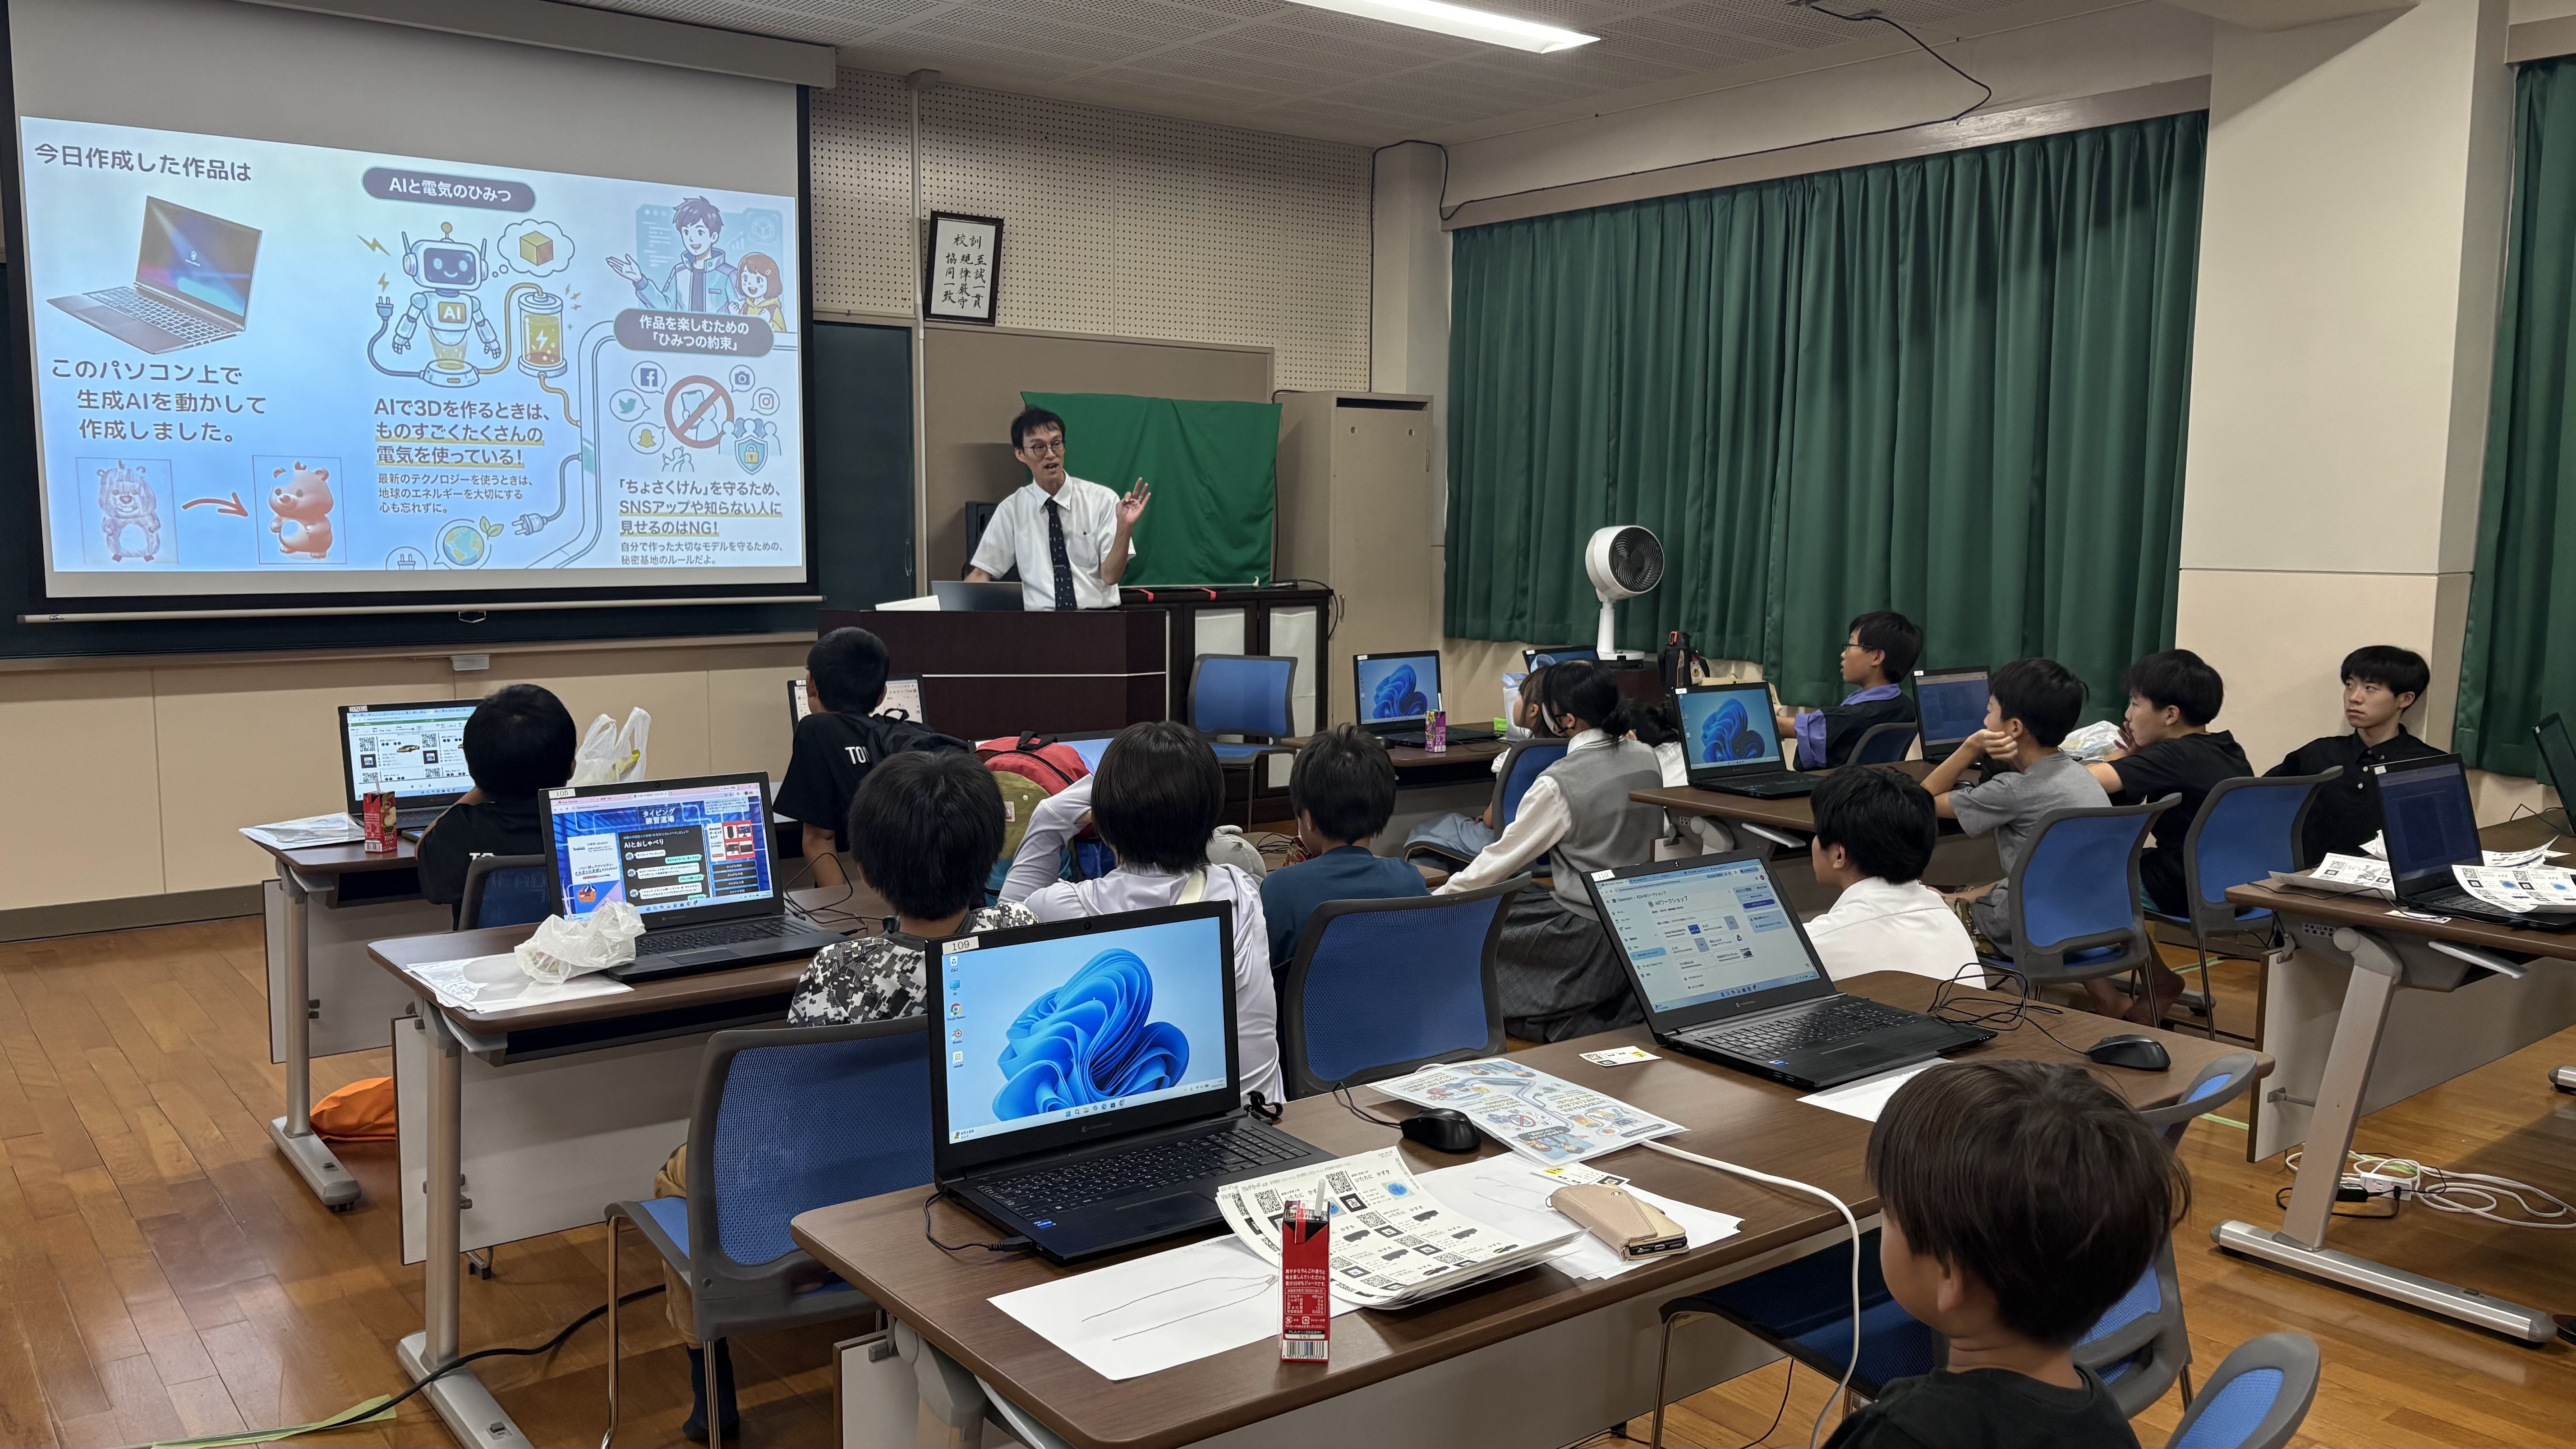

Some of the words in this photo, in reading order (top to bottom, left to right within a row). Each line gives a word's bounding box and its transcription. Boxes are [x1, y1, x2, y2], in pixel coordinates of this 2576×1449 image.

[35, 143, 251, 181] 今日作成した作品は
[389, 178, 511, 202] AIと電気のひみつ
[953, 234, 981, 249] 校訓
[971, 254, 987, 308] 至誠一貫
[443, 307, 461, 320] AI
[639, 315, 749, 335] 作品を楽しむための
[653, 331, 737, 351] 「ひみつの約束」
[51, 359, 242, 385] このパソコン上で
[77, 389, 266, 414] 生成AIを動かして
[374, 398, 550, 420] AIで3Dを作るときは、
[79, 419, 233, 442] 作成しました。
[376, 422, 543, 442] ものすごくたくさんの
[377, 446, 522, 465] 電気を使っている!
[378, 473, 533, 486] 最新のテクノロジーを使うときは、
[620, 478, 780, 496] 「ちょさくけん」を守るため、
[379, 488, 523, 500] 地球のエネルギーを大切にする
[379, 502, 448, 513] 心も忘れずに。
[620, 500, 782, 515] SNSアップや知らない人に
[621, 520, 718, 535] 見せるのはNG!
[621, 542, 783, 552] 自分で作った大切なモデルを守るための、
[621, 555, 715, 565] 秘密基地のルールだよ。
[643, 807, 675, 817] タイピング
[624, 838, 664, 848] AIとおしゃべり
[952, 940, 970, 951] 109
